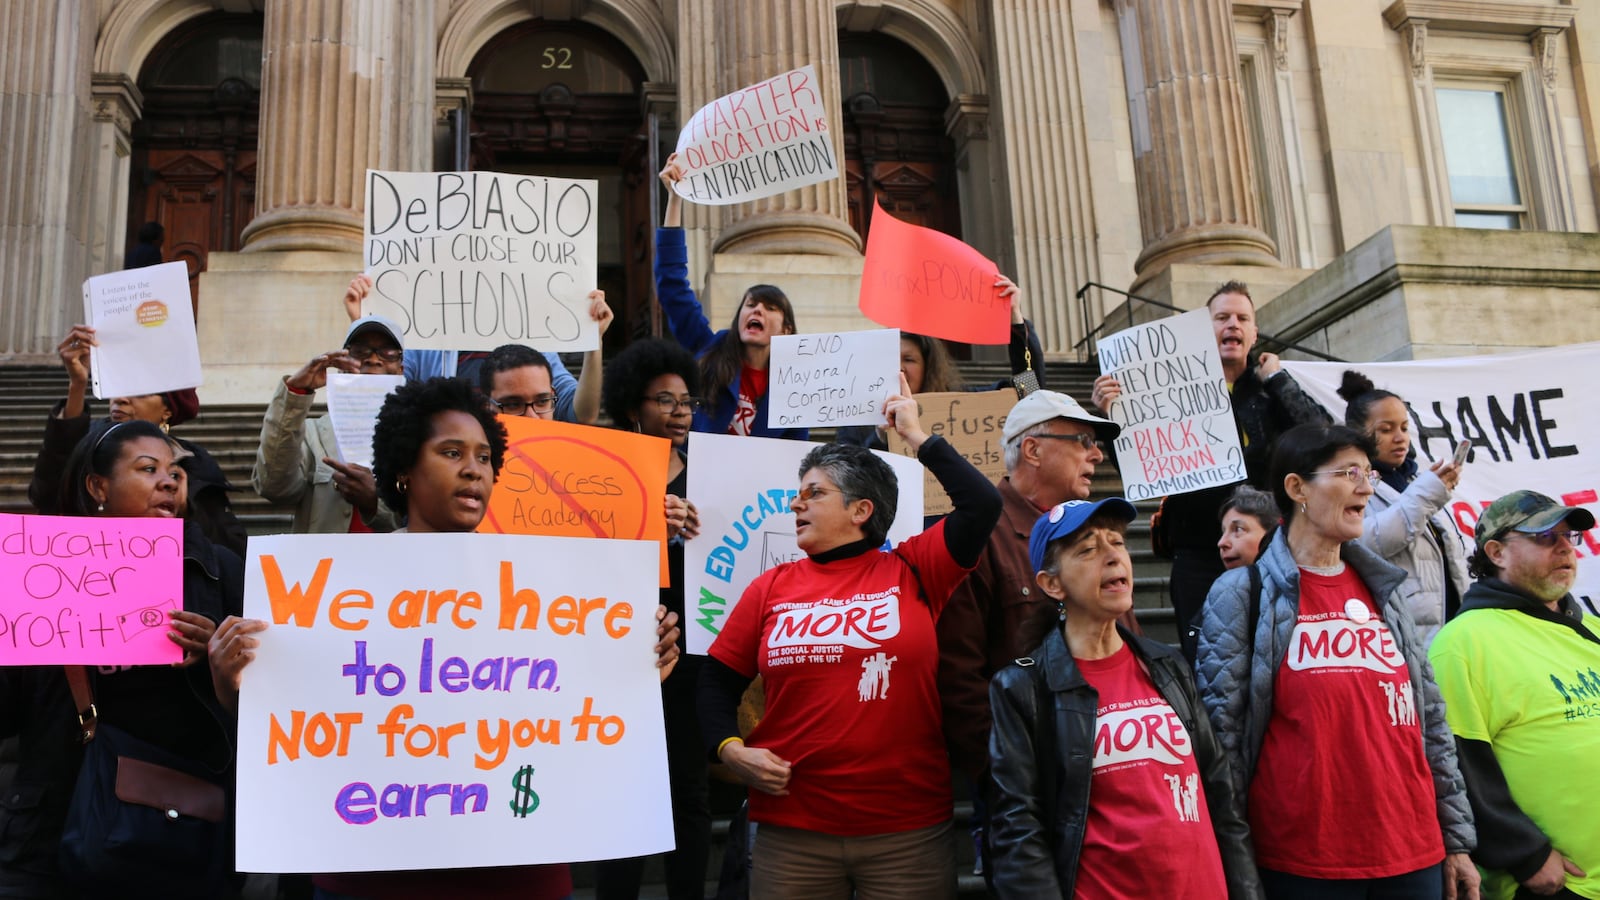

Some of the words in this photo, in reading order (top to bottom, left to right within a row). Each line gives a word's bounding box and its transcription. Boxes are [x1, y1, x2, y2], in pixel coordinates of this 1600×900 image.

[541, 48, 572, 69] 52
[690, 70, 816, 142] HARTER
[680, 108, 811, 176] OLOCATION
[814, 117, 828, 132] IS
[369, 235, 443, 266] DON'T
[451, 233, 519, 263] CLOSE
[532, 240, 578, 266] OUR
[102, 286, 126, 296] Listen
[127, 282, 136, 290] to
[137, 280, 150, 289] the
[102, 295, 129, 305] voices
[139, 291, 153, 299] the
[375, 269, 581, 342] SCHOOLS
[797, 335, 843, 357] END
[1100, 329, 1142, 370] WHY
[1147, 323, 1177, 358] DO
[777, 353, 854, 385] Mayoral
[868, 376, 885, 392] of
[1154, 350, 1209, 388] ONLY
[1110, 392, 1168, 431] CLOSE
[1168, 378, 1231, 423] SCHOOLS
[1133, 420, 1199, 462] BLACK
[1201, 416, 1224, 446] &
[1403, 388, 1579, 464] HAME
[1143, 444, 1217, 483] BROWN
[2, 516, 180, 559] ducation
[512, 497, 616, 539] Academy
[705, 488, 798, 584] EDUCATI
[24, 563, 136, 599] Over
[259, 554, 374, 631] We
[387, 588, 482, 629] are
[498, 560, 633, 639] here
[695, 585, 726, 636] MY
[772, 602, 813, 613] MOVEMENT
[823, 598, 844, 606] RANK
[774, 603, 890, 642] MORE
[768, 649, 780, 658] THE
[781, 646, 809, 656] SOCIAL
[811, 645, 844, 654] JUSTICE
[768, 656, 794, 667] CAUCUS
[795, 655, 806, 664] OF
[808, 655, 825, 663] THE
[826, 654, 842, 663] UFT
[1298, 627, 1396, 664] MORE
[342, 640, 406, 697] to
[1109, 702, 1118, 710] OF
[267, 710, 363, 765] NOT
[377, 704, 466, 758] for
[474, 718, 561, 771] you
[571, 697, 625, 745] to
[334, 781, 489, 825] earn
[509, 765, 540, 819] $
